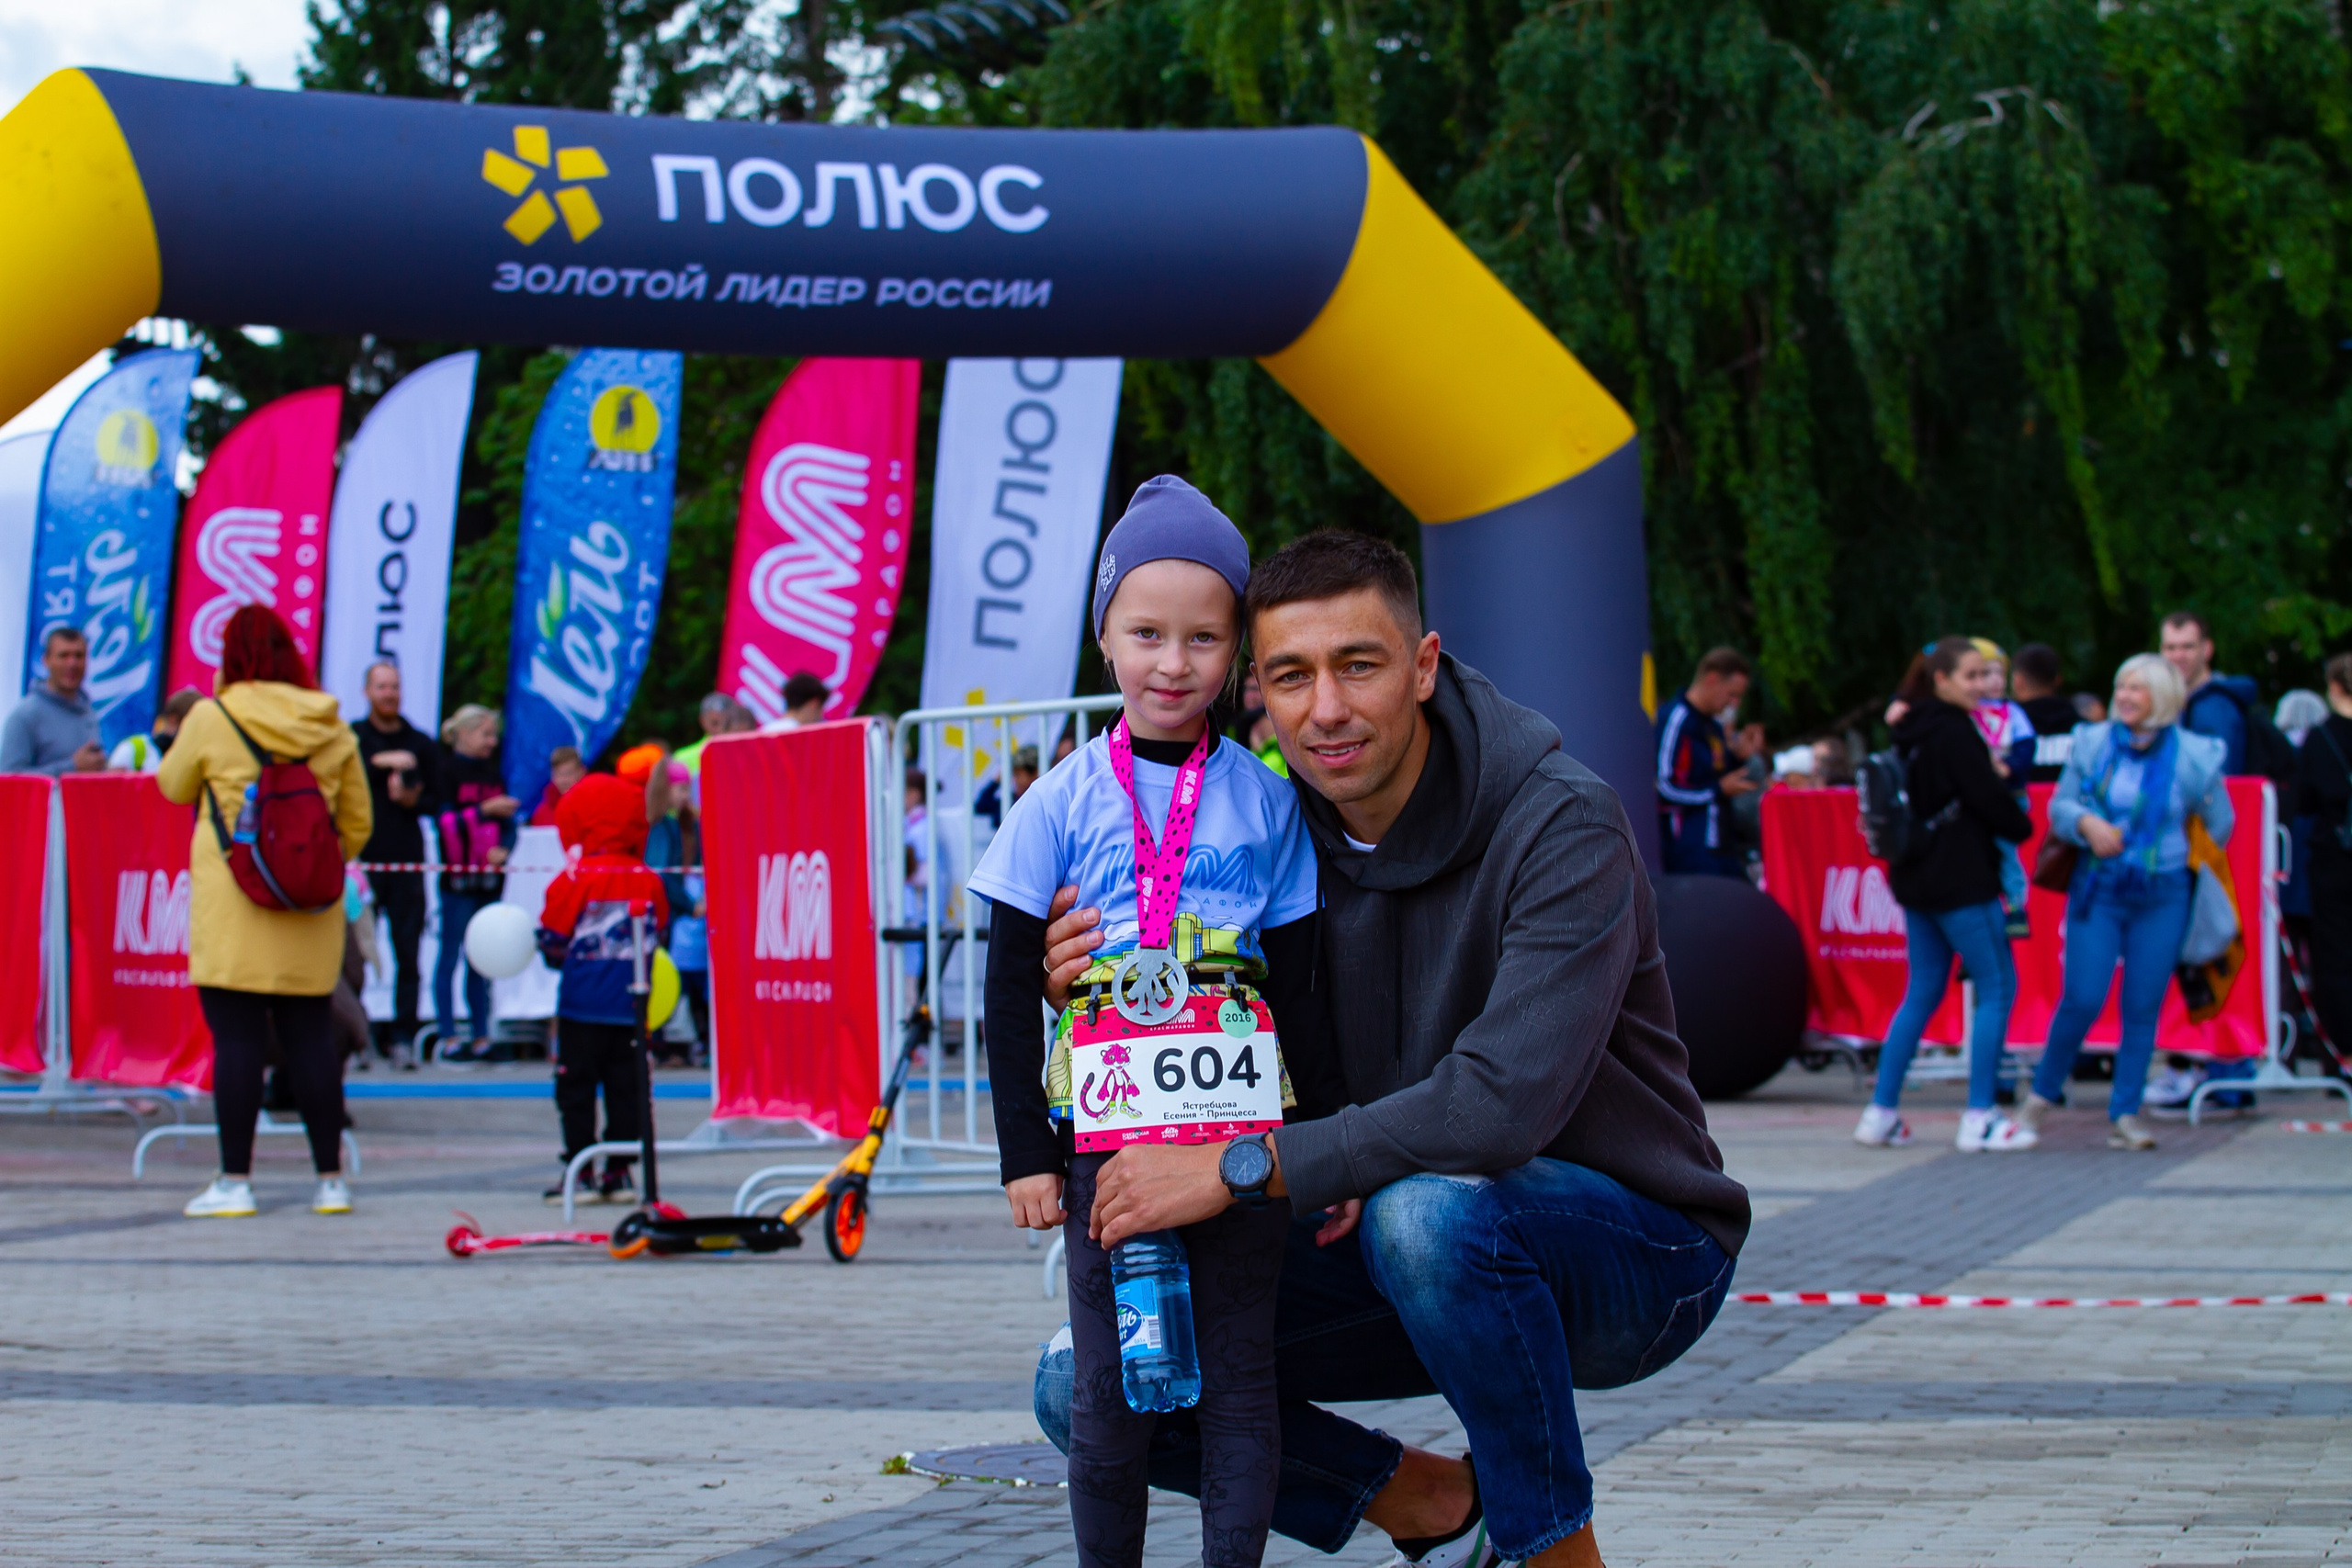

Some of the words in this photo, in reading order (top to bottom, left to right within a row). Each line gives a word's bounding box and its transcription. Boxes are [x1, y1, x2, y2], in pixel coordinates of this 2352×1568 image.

[650, 152, 1051, 234] ПОЛЮС
[492, 262, 708, 301] ЗОЛОТОЙ
[716, 271, 868, 310] ЛИДЕР
[875, 277, 1054, 310] РОССИИ
[376, 499, 418, 668] ЛЮС
[1225, 1012, 1251, 1023] 2016
[1153, 1044, 1262, 1093] 604
[1163, 1111, 1197, 1121] Есения
[1206, 1110, 1258, 1120] Принцесса
[1182, 1101, 1238, 1111] Ястребцова
